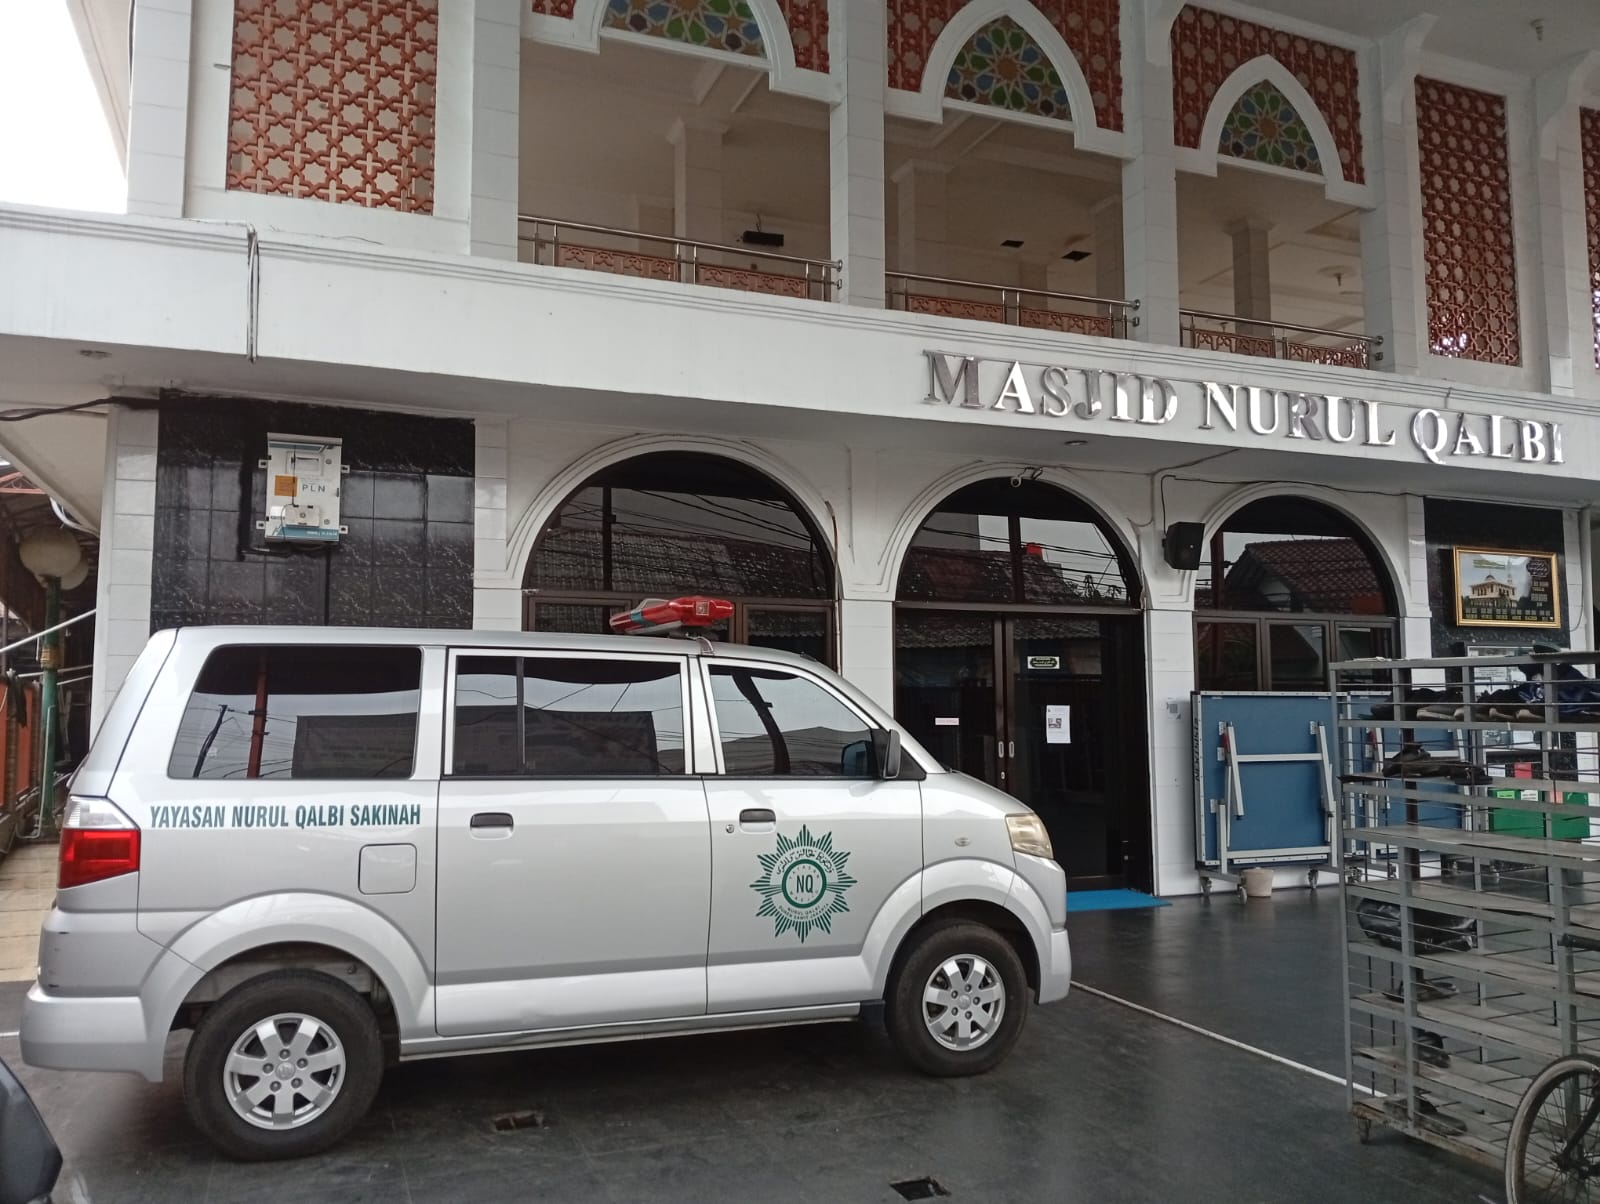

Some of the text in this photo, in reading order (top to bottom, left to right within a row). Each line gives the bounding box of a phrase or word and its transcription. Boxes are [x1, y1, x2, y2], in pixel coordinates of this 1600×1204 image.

[923, 351, 1565, 465] MASJID NURUL QALBI
[302, 484, 326, 493] PLN
[150, 803, 421, 829] YAYASAN NURUL QALBI SAKINAH
[796, 874, 814, 893] NQ
